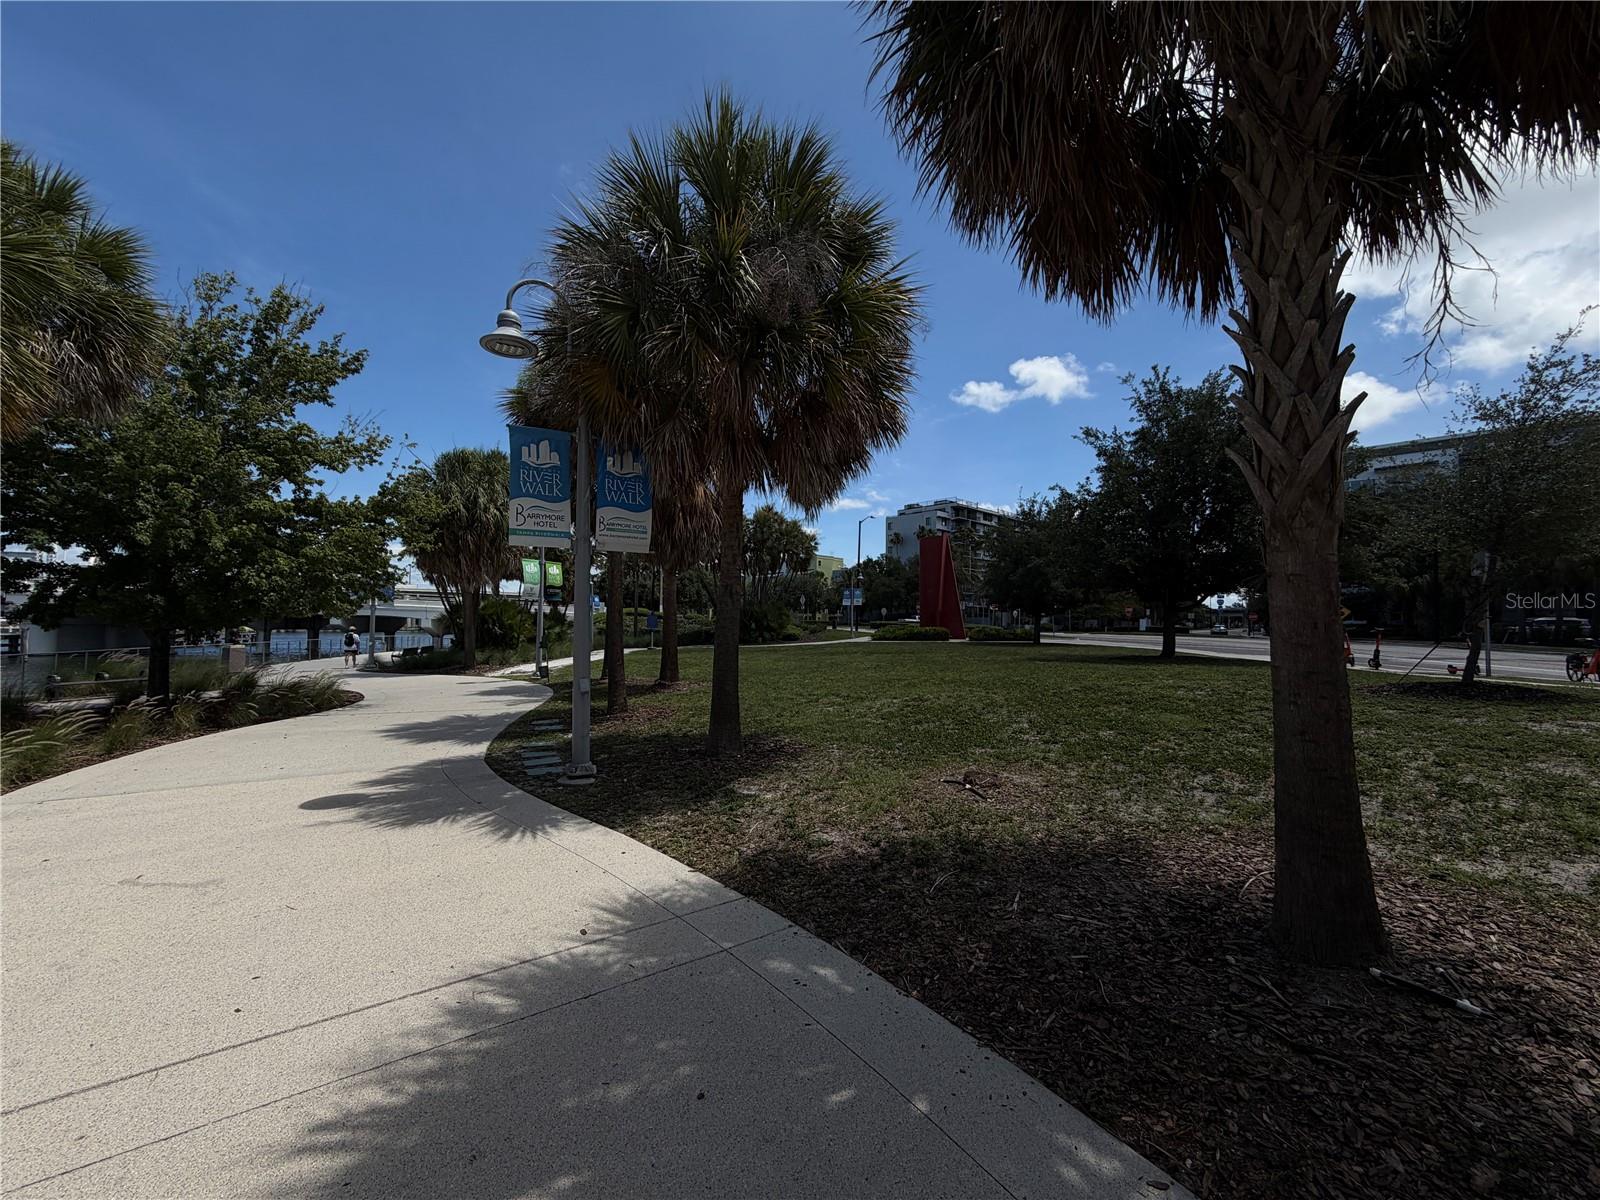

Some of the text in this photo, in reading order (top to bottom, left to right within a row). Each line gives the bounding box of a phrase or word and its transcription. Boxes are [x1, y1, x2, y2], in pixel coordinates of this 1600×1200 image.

[520, 468, 561, 484] RIVER
[520, 481, 563, 497] WALK
[605, 477, 645, 494] RIVER
[605, 489, 646, 505] WALK
[516, 503, 565, 527] BARRYMORE
[533, 520, 558, 529] HOTEL
